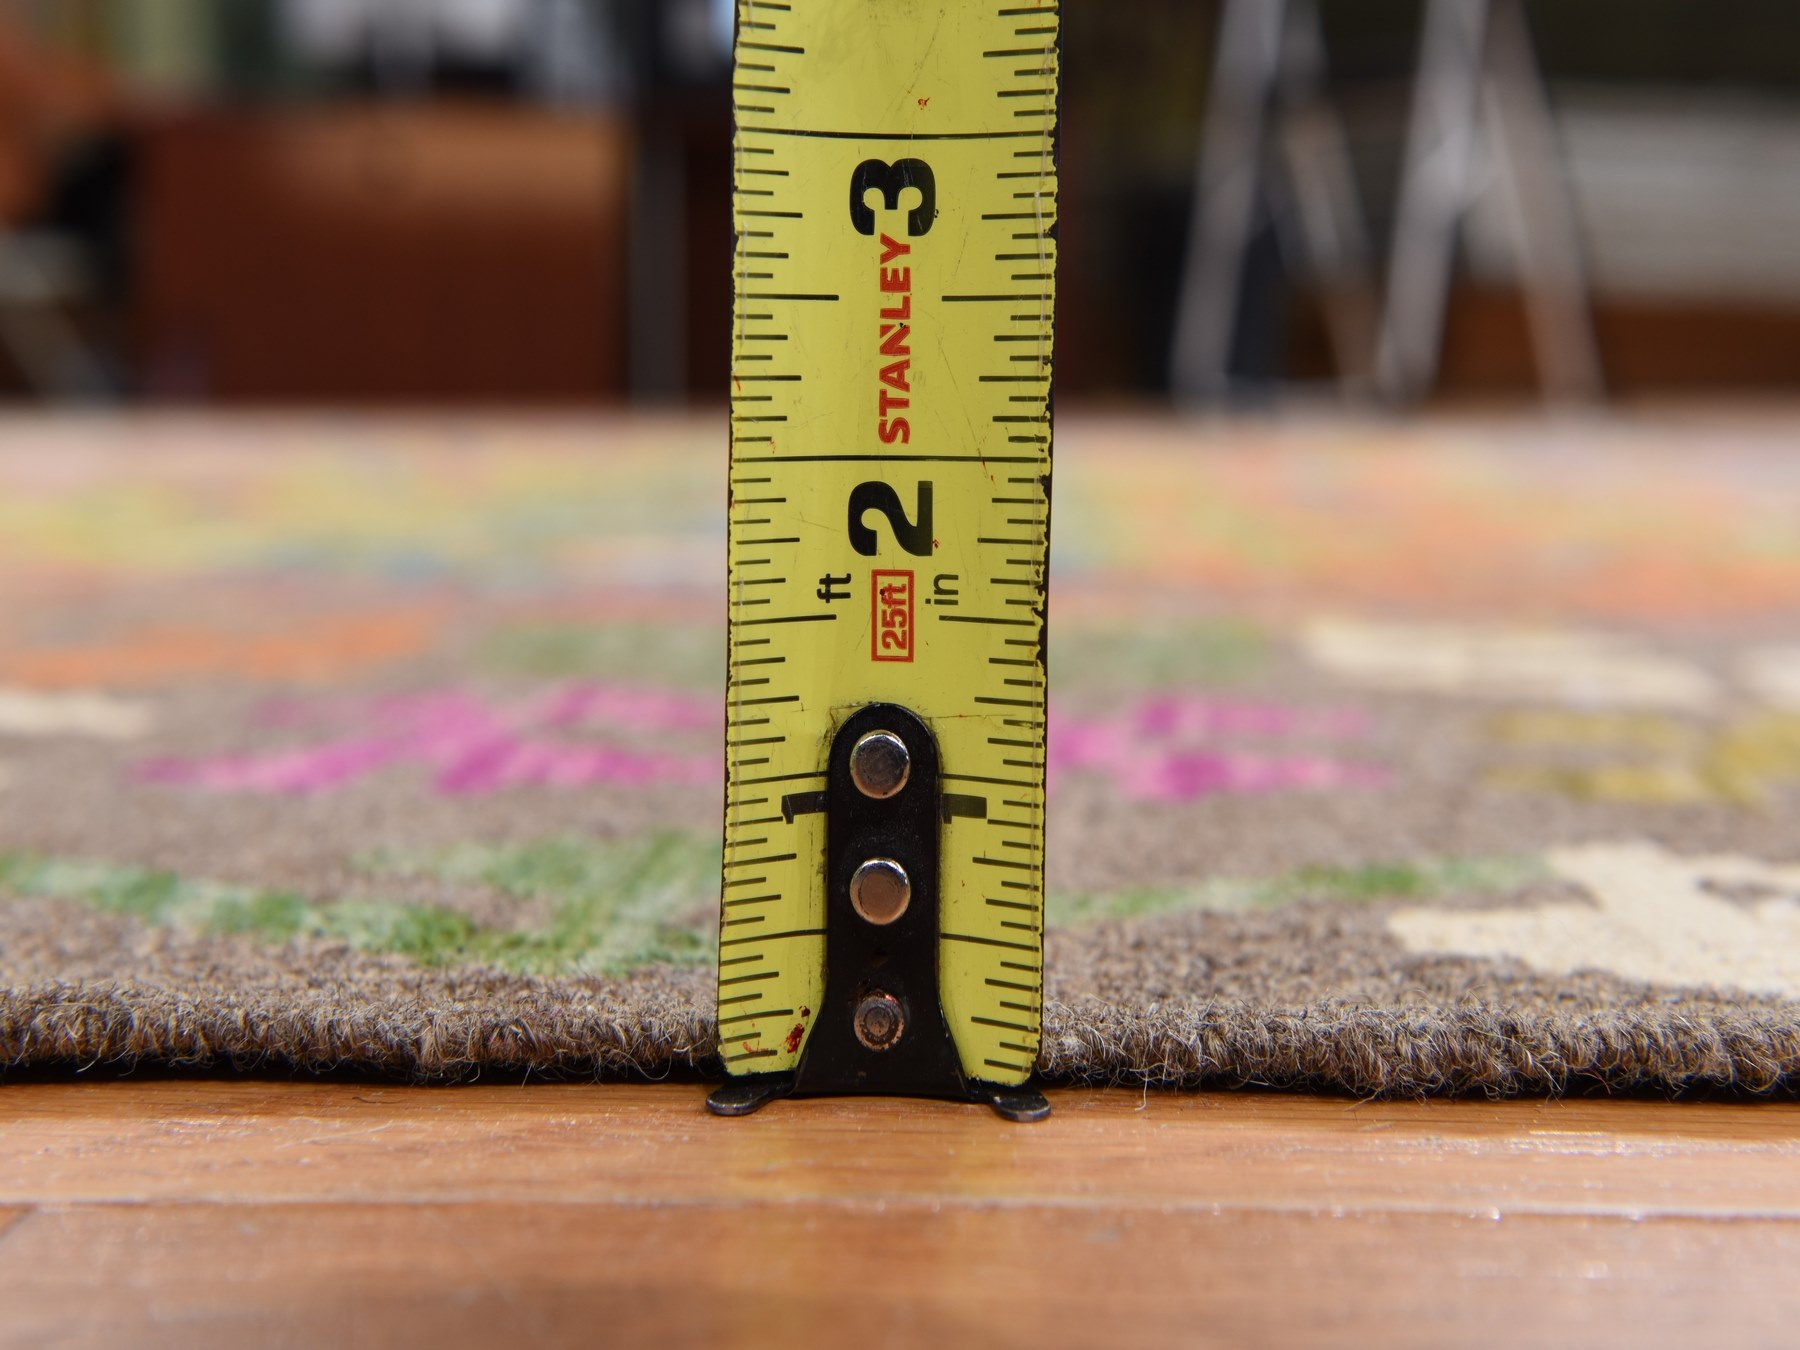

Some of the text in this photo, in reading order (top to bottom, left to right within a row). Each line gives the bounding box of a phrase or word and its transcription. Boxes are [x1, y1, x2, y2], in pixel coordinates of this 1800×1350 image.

[850, 157, 936, 237] 3
[878, 232, 911, 444] STANLEY
[848, 480, 933, 557] 2
[817, 573, 851, 603] ft
[881, 583, 907, 650] 25ft
[925, 573, 959, 605] in
